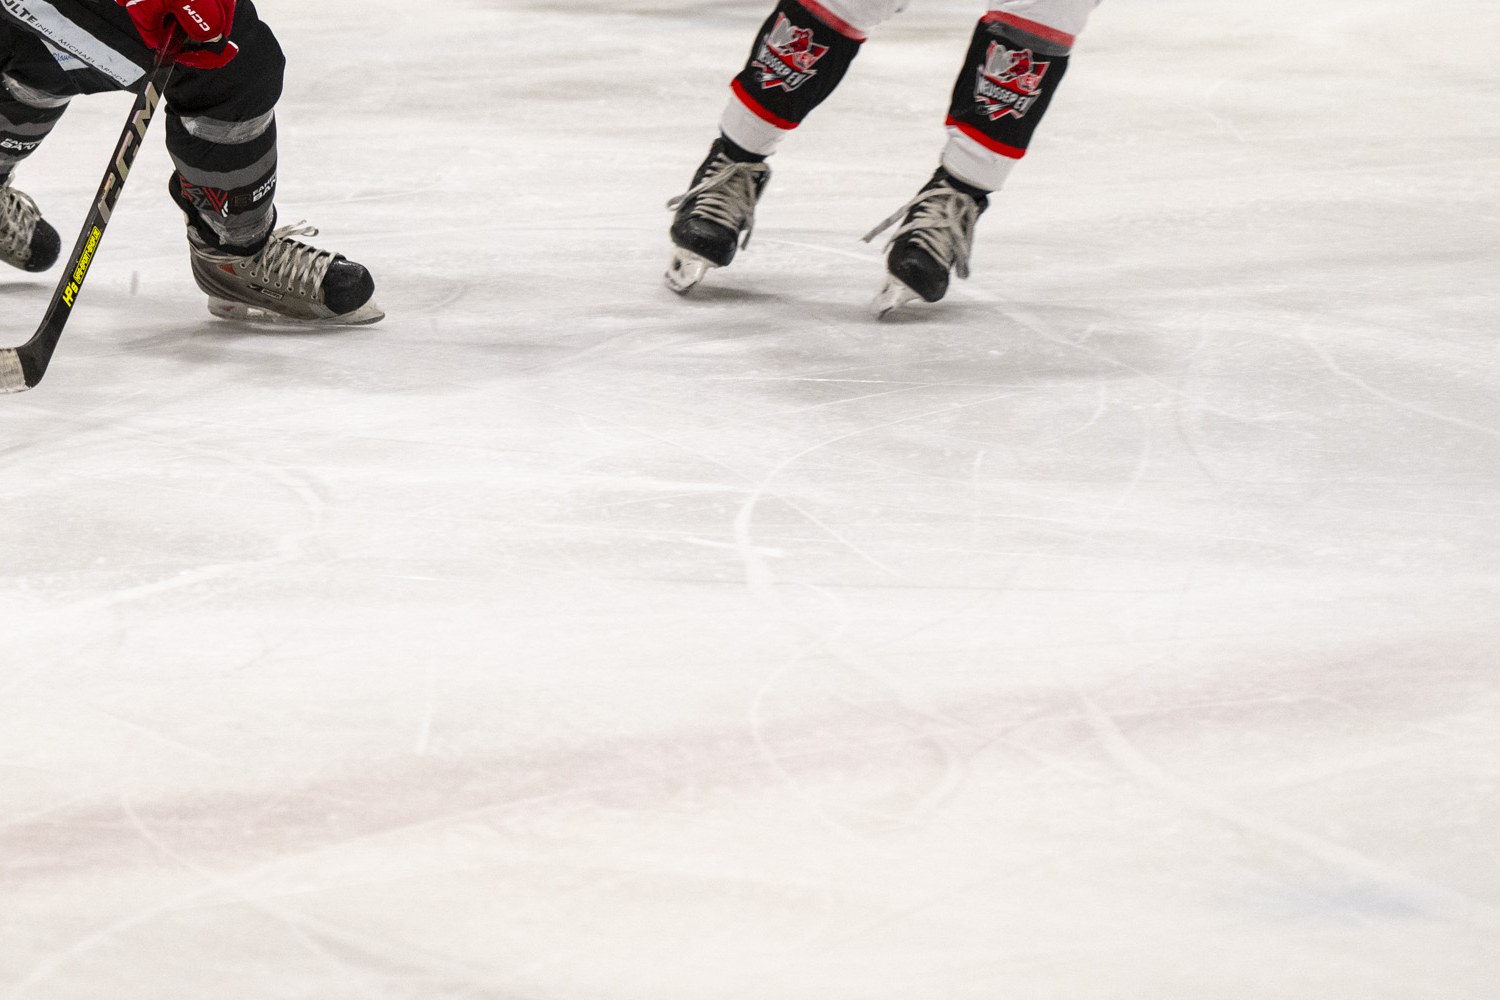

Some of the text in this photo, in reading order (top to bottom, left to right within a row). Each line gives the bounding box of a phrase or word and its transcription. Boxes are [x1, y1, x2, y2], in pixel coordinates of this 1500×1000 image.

[182, 4, 211, 32] CCM
[97, 63, 130, 85] ARNDT
[97, 81, 161, 225] CCM
